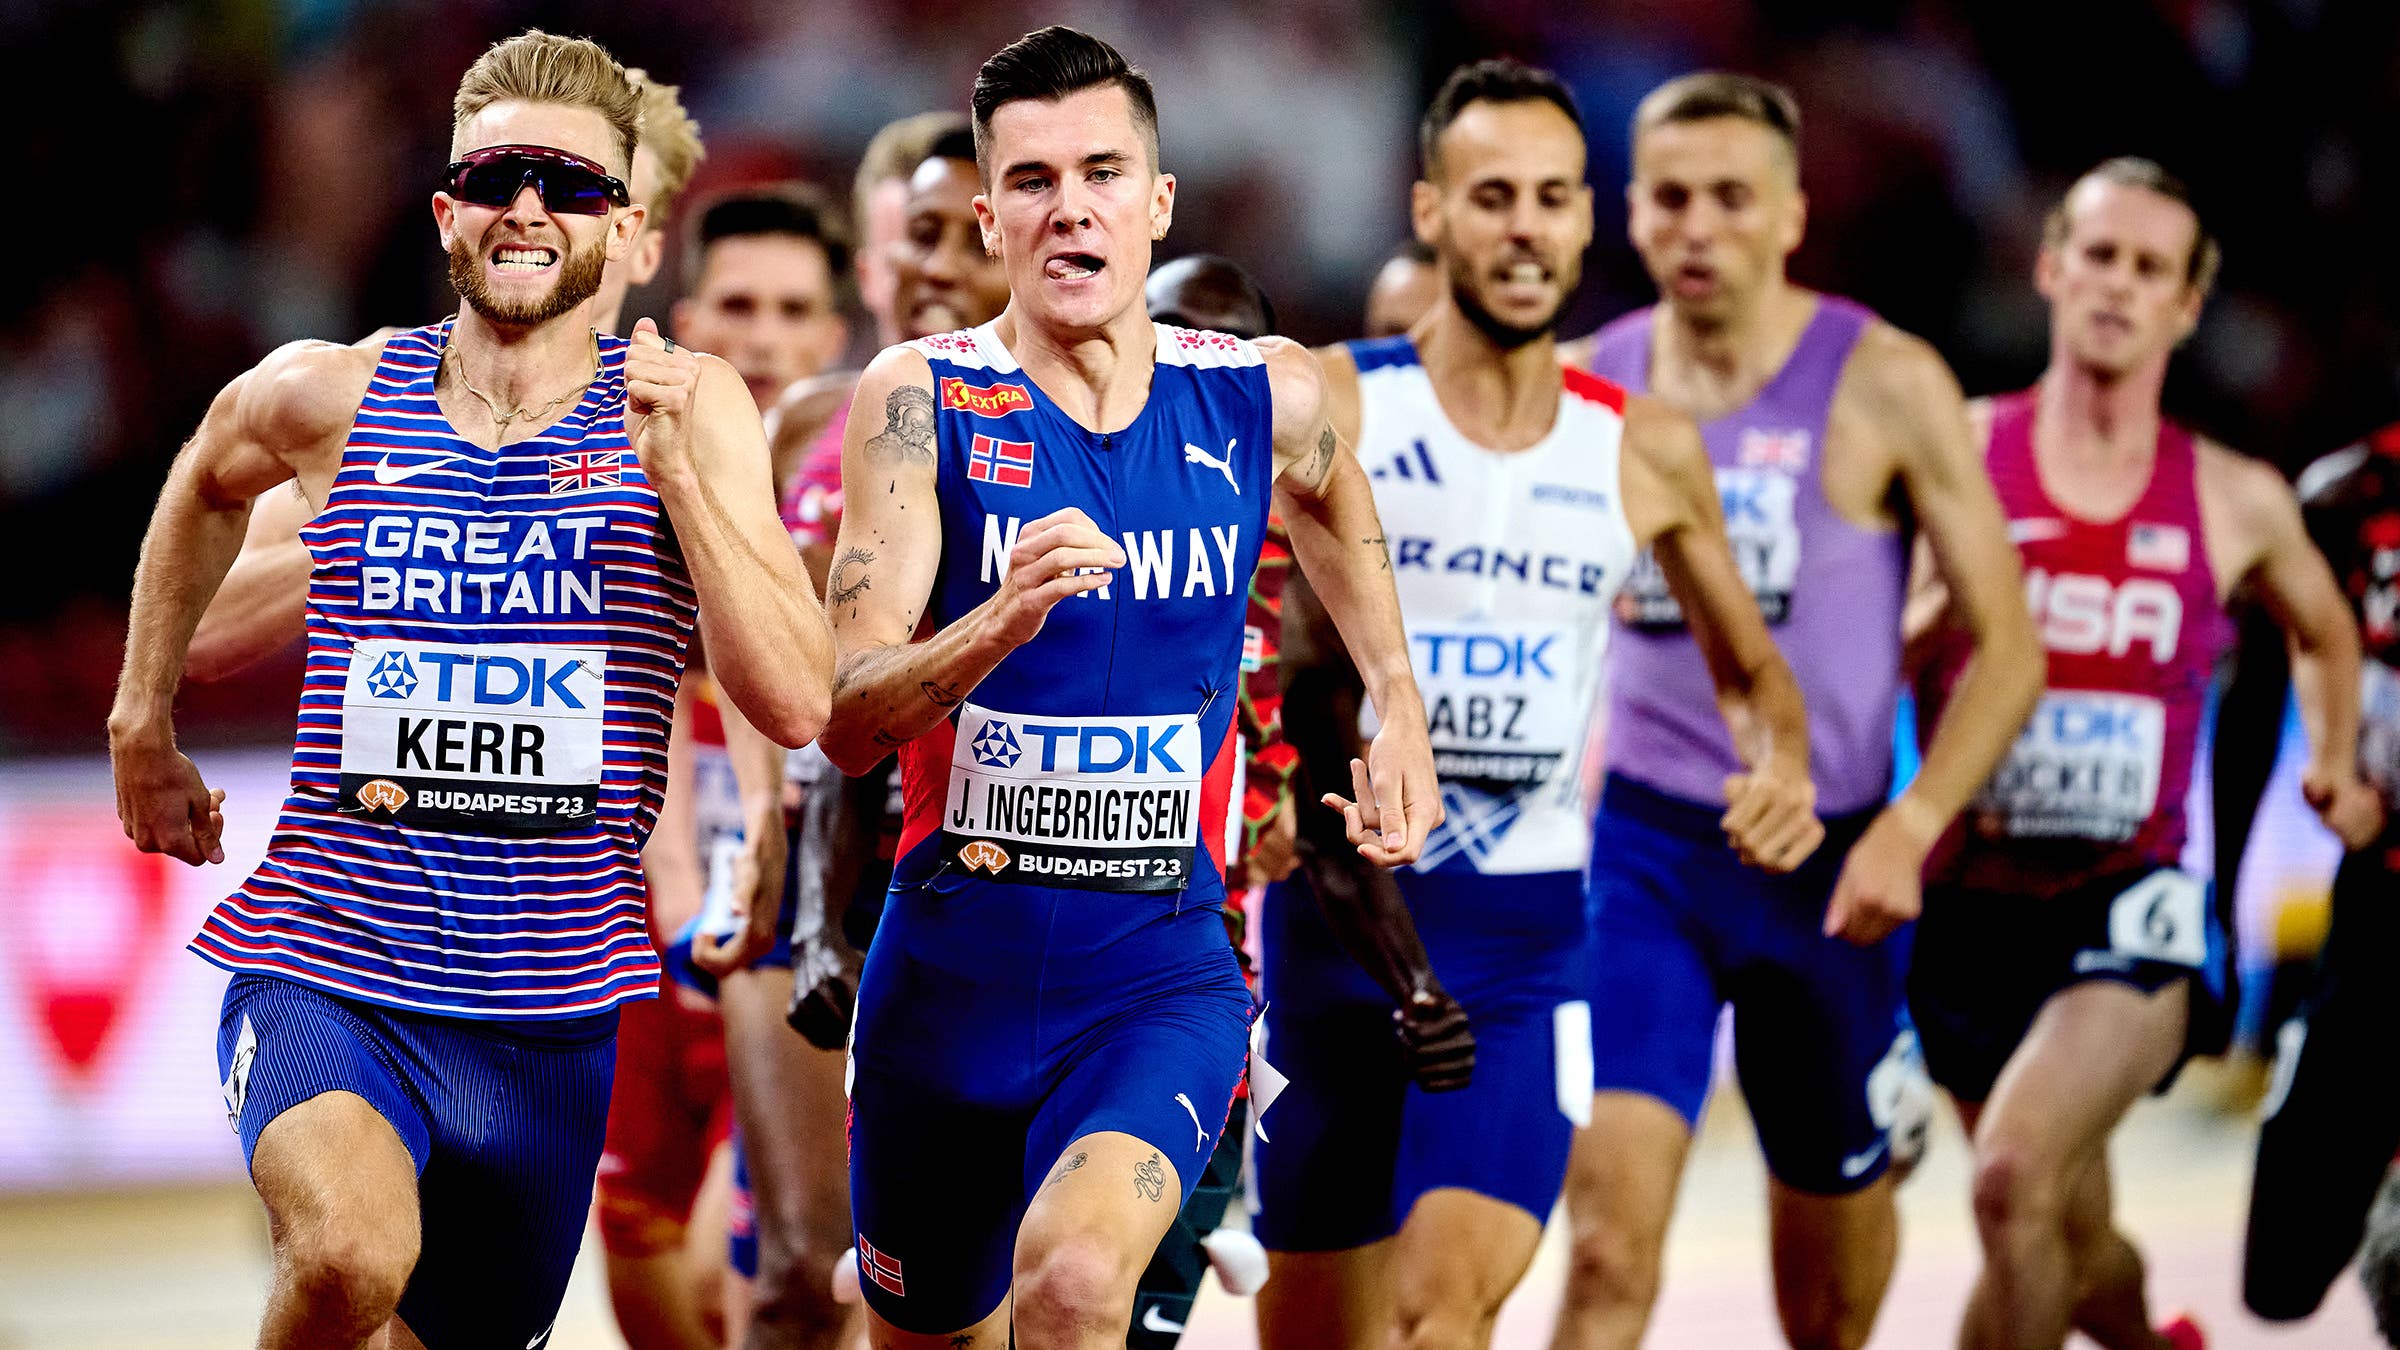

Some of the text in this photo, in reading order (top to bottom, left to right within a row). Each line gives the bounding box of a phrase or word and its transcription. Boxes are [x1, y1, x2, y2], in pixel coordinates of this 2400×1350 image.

[970, 390, 1024, 410] EXTRA
[365, 516, 606, 563] GREAT
[980, 512, 1239, 600] NWAY
[362, 566, 600, 614] BRITAIN
[419, 650, 587, 709] TDK
[1413, 632, 1559, 681] TDK
[1428, 694, 1526, 741] ABZ
[396, 716, 546, 777] KERR
[1021, 723, 1184, 775] TDK
[417, 790, 584, 814] BUDAPEST 23
[953, 778, 1190, 842] J. INGEBRIGTSEN
[1019, 854, 1181, 877] BUDAPEST 23
[2144, 897, 2175, 947] 6
